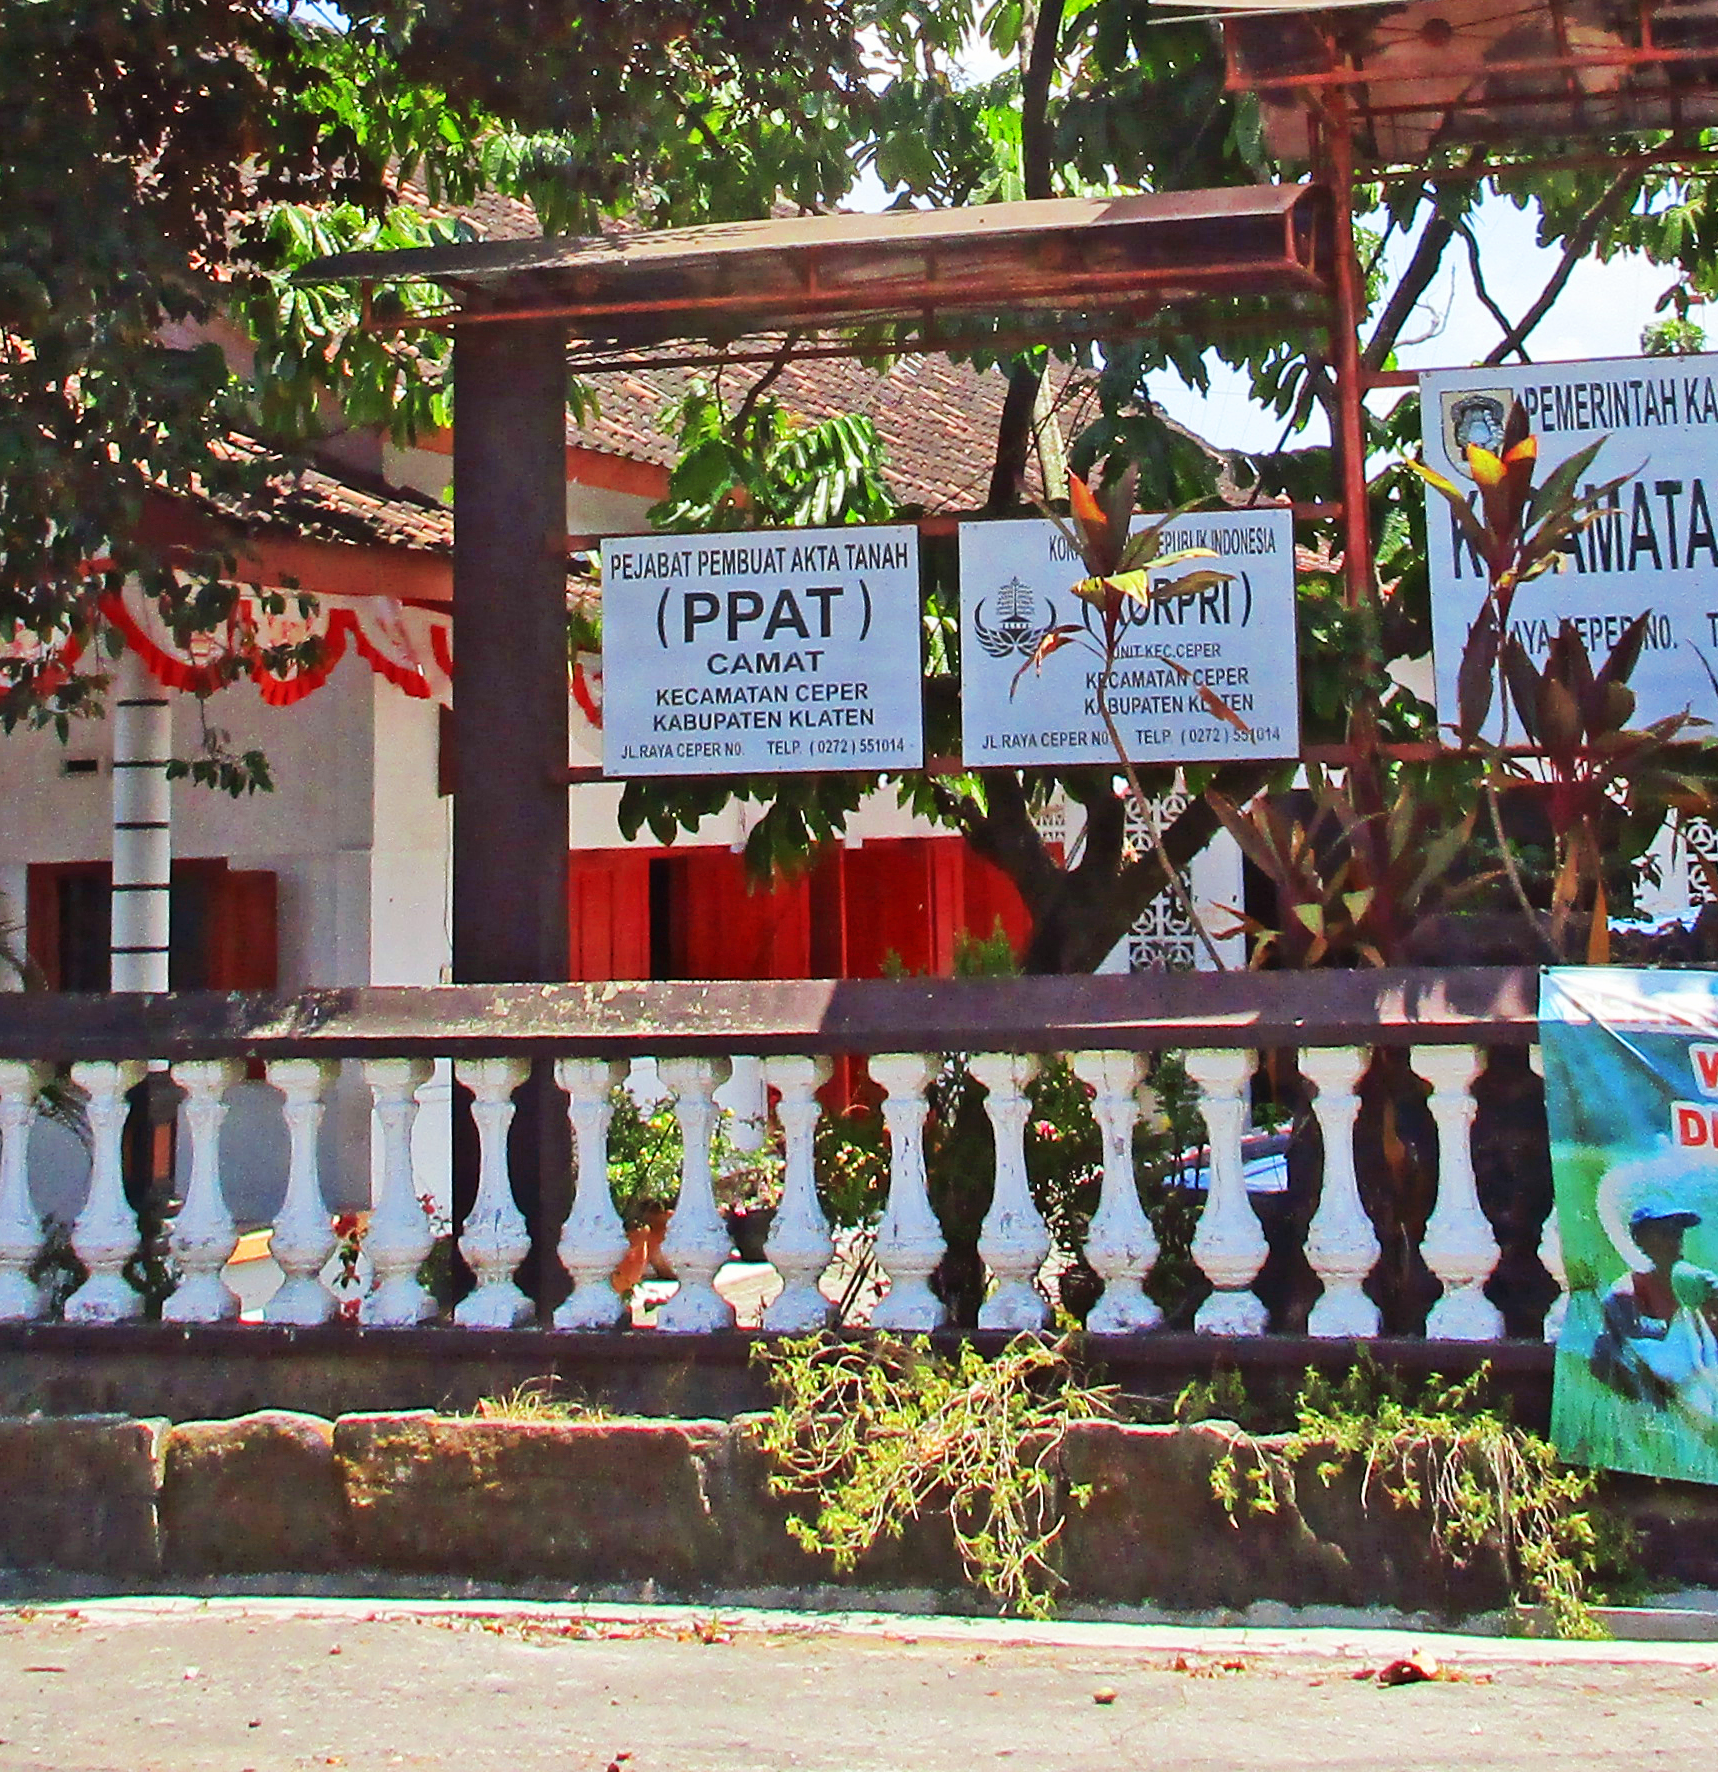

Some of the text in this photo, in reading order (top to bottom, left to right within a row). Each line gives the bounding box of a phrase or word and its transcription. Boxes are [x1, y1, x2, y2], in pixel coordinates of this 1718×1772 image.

[1524, 378, 1678, 432] PEMERINTAH
[1212, 528, 1277, 556] INDONESIA
[610, 543, 909, 580] PEJABAT PEMBUAT AKTA TANAH
[707, 650, 825, 675] CAMAT
[1192, 667, 1249, 686] CEPER
[656, 683, 869, 707] KECAMATAN CEPER
[1188, 693, 1253, 713] KLTEN
[653, 708, 875, 732] KABUPATEN KLATEN
[677, 742, 721, 758] CEPER
[859, 738, 905, 754] 551014
[1040, 731, 1088, 747] CEPER
